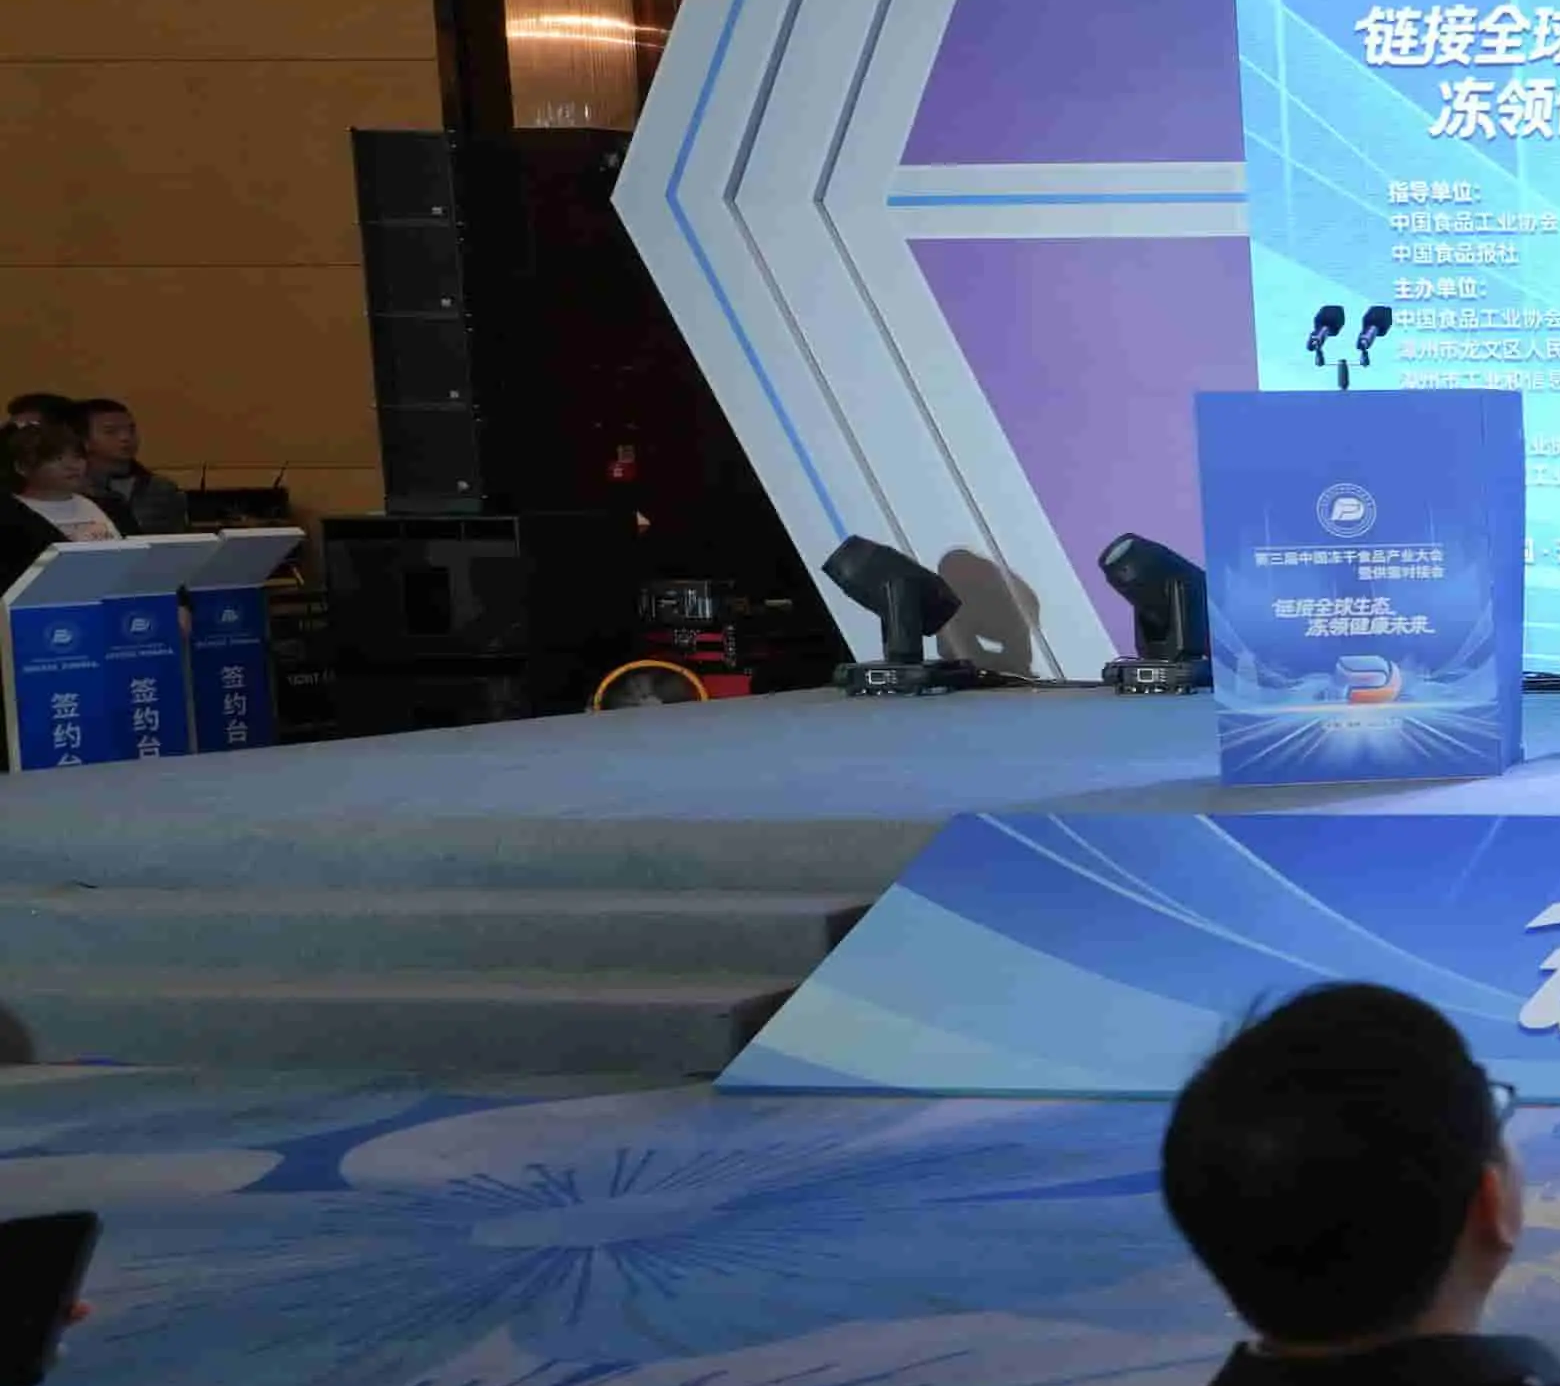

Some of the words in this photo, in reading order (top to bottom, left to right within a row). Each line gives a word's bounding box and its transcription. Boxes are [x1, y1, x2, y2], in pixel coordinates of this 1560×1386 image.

[1389, 212, 1560, 234] 中国食品工业协会
[1391, 243, 1521, 266] 中国食品报社
[220, 665, 248, 744] 签约台
